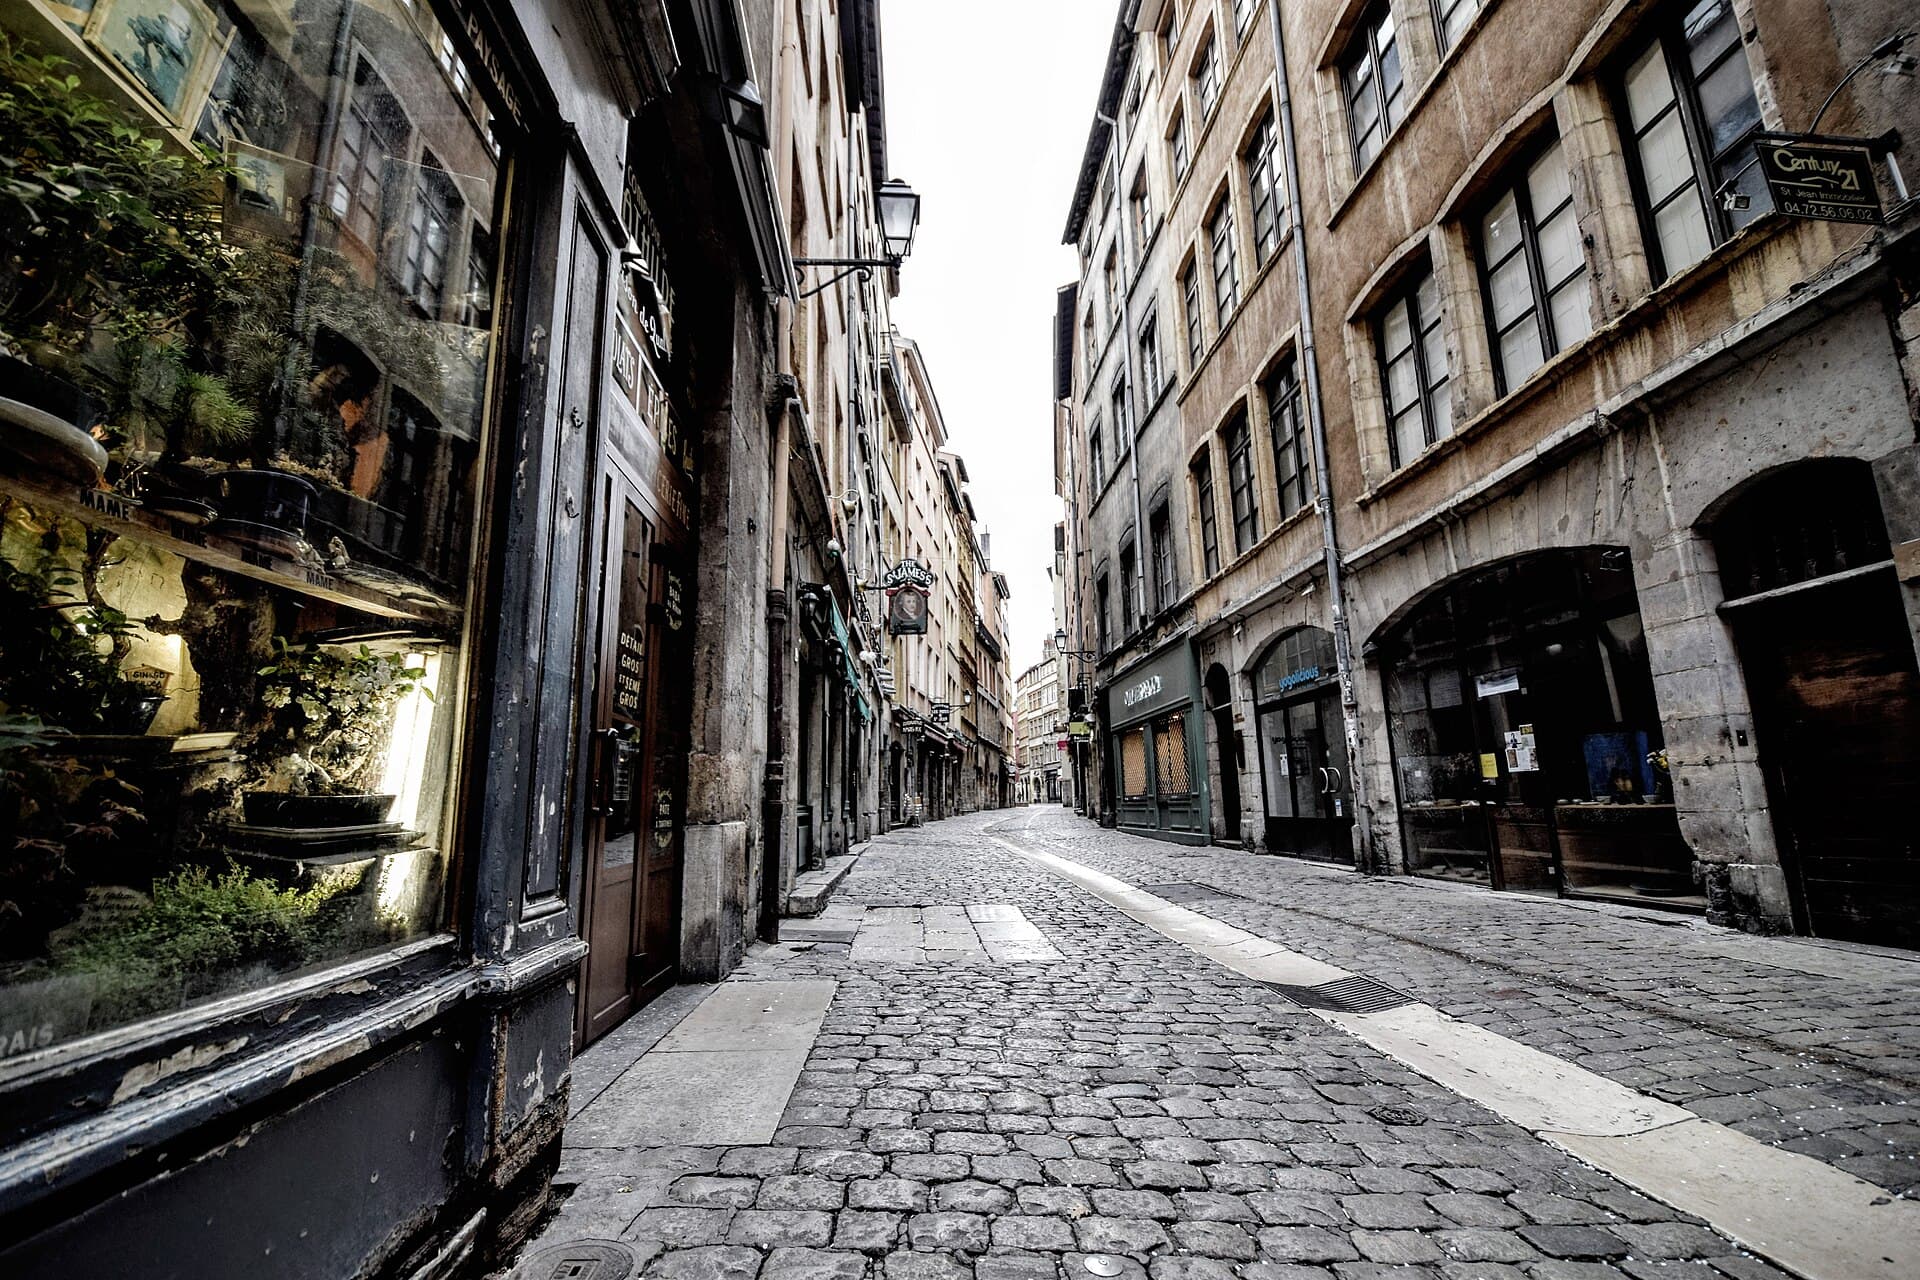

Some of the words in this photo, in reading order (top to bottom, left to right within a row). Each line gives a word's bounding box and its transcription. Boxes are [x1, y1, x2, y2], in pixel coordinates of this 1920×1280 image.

[466, 10, 522, 127] PAYSAGE
[1773, 149, 1841, 176] Century
[1838, 169, 1860, 190] 21
[1796, 189, 1818, 199] Jean
[1784, 201, 1873, 220] 04.72.56.06.02
[79, 487, 130, 522] MAME
[901, 560, 917, 568] THE
[306, 571, 334, 591] MAME
[621, 653, 640, 674] GROS
[624, 676, 641, 695] SEMI
[1279, 666, 1318, 692] yogolicious
[619, 691, 638, 710] GROS
